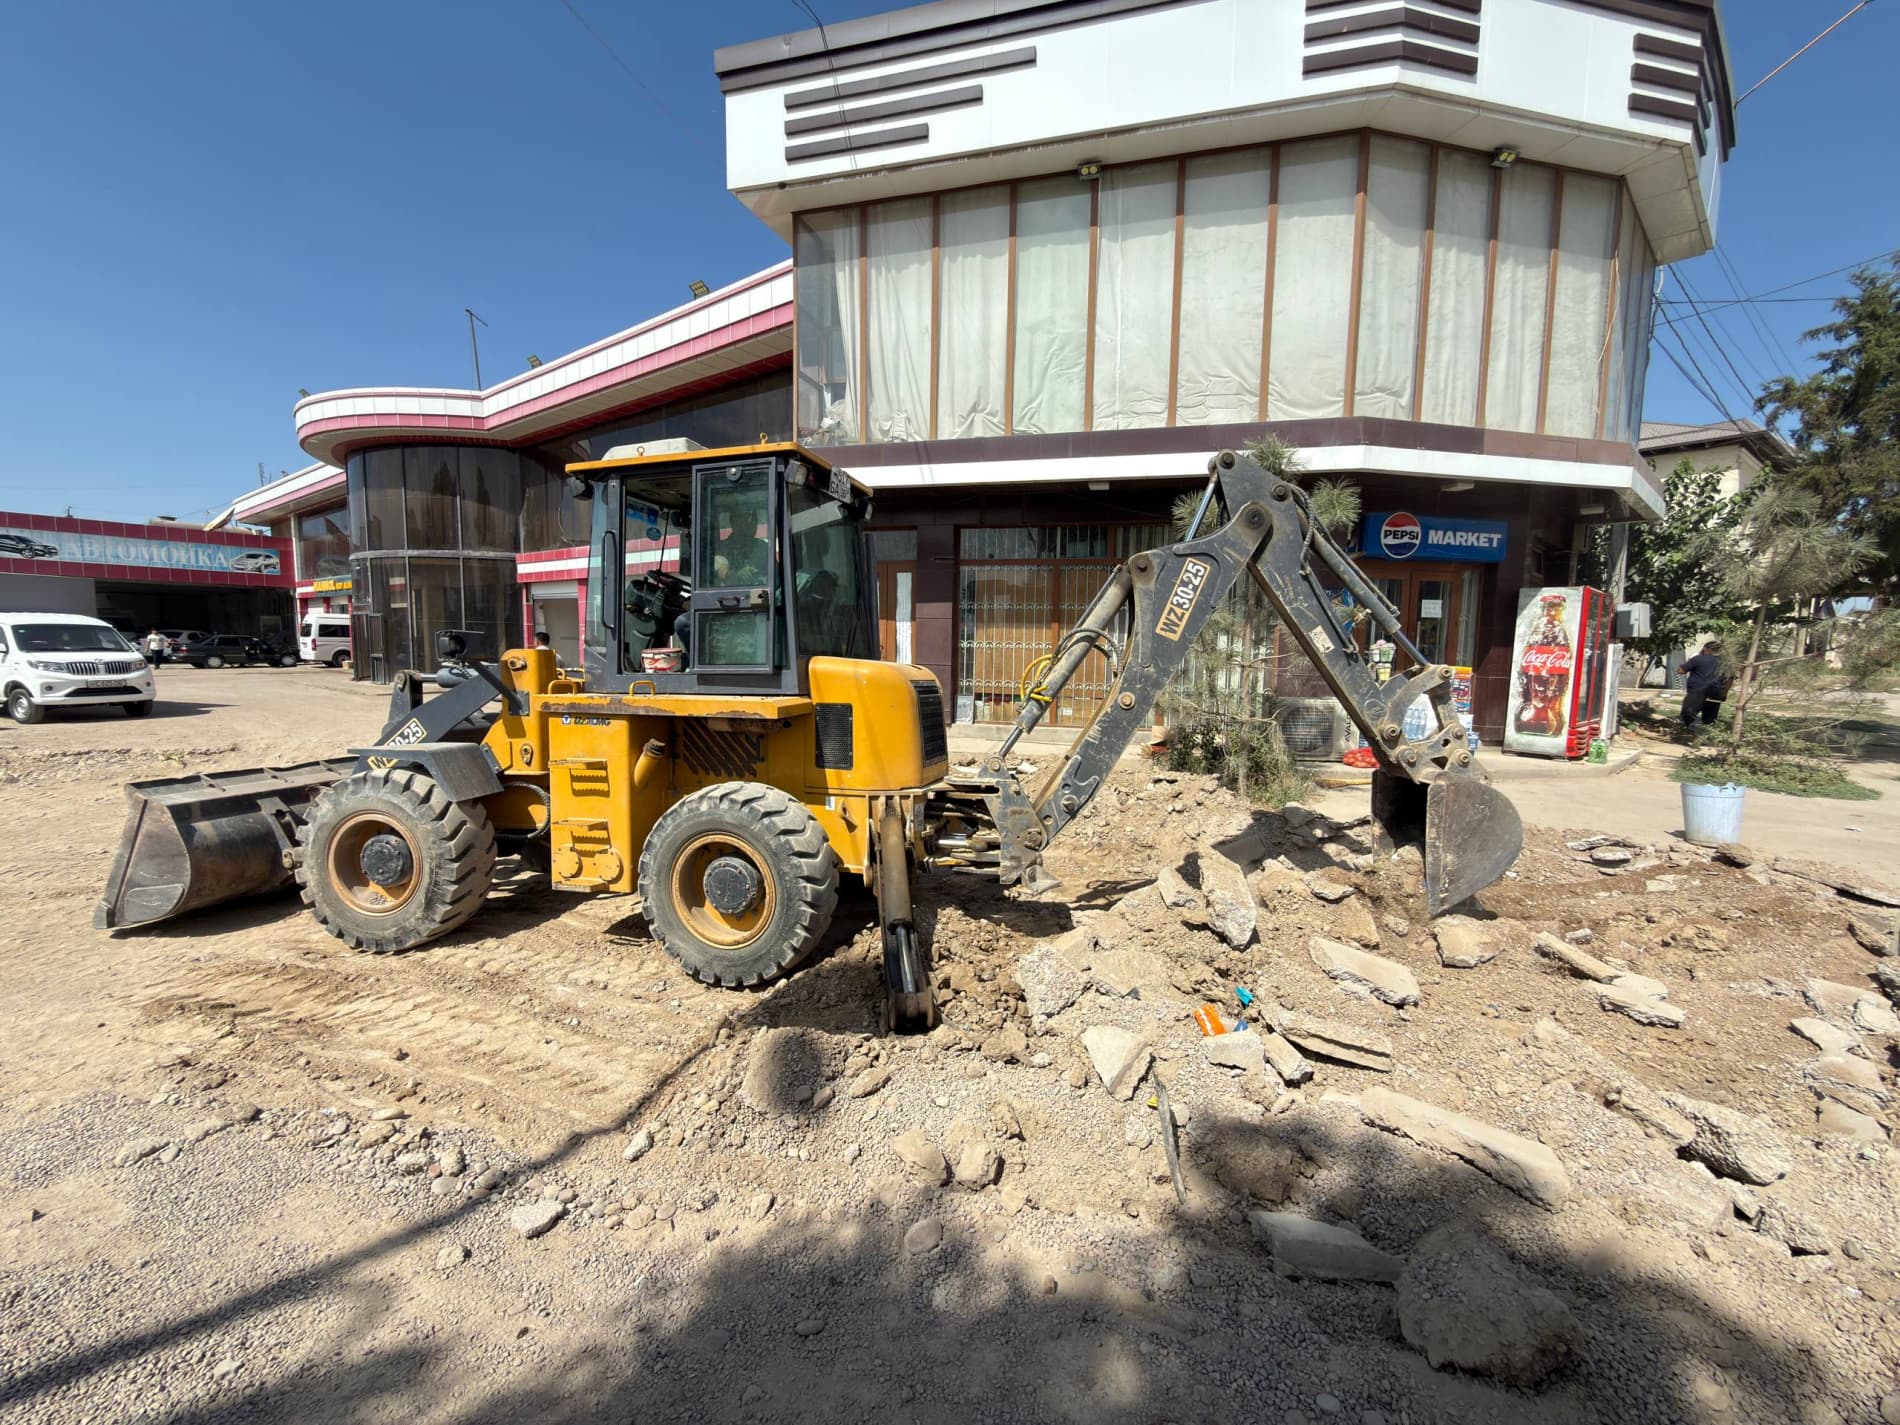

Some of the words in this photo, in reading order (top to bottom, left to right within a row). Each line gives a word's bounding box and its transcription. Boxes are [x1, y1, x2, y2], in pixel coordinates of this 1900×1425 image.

[1383, 529, 1419, 541] PEPSI
[1427, 529, 1502, 548] MARKET
[66, 539, 229, 567] АВТОМОЙКА
[1521, 649, 1570, 668] Coca-Cola
